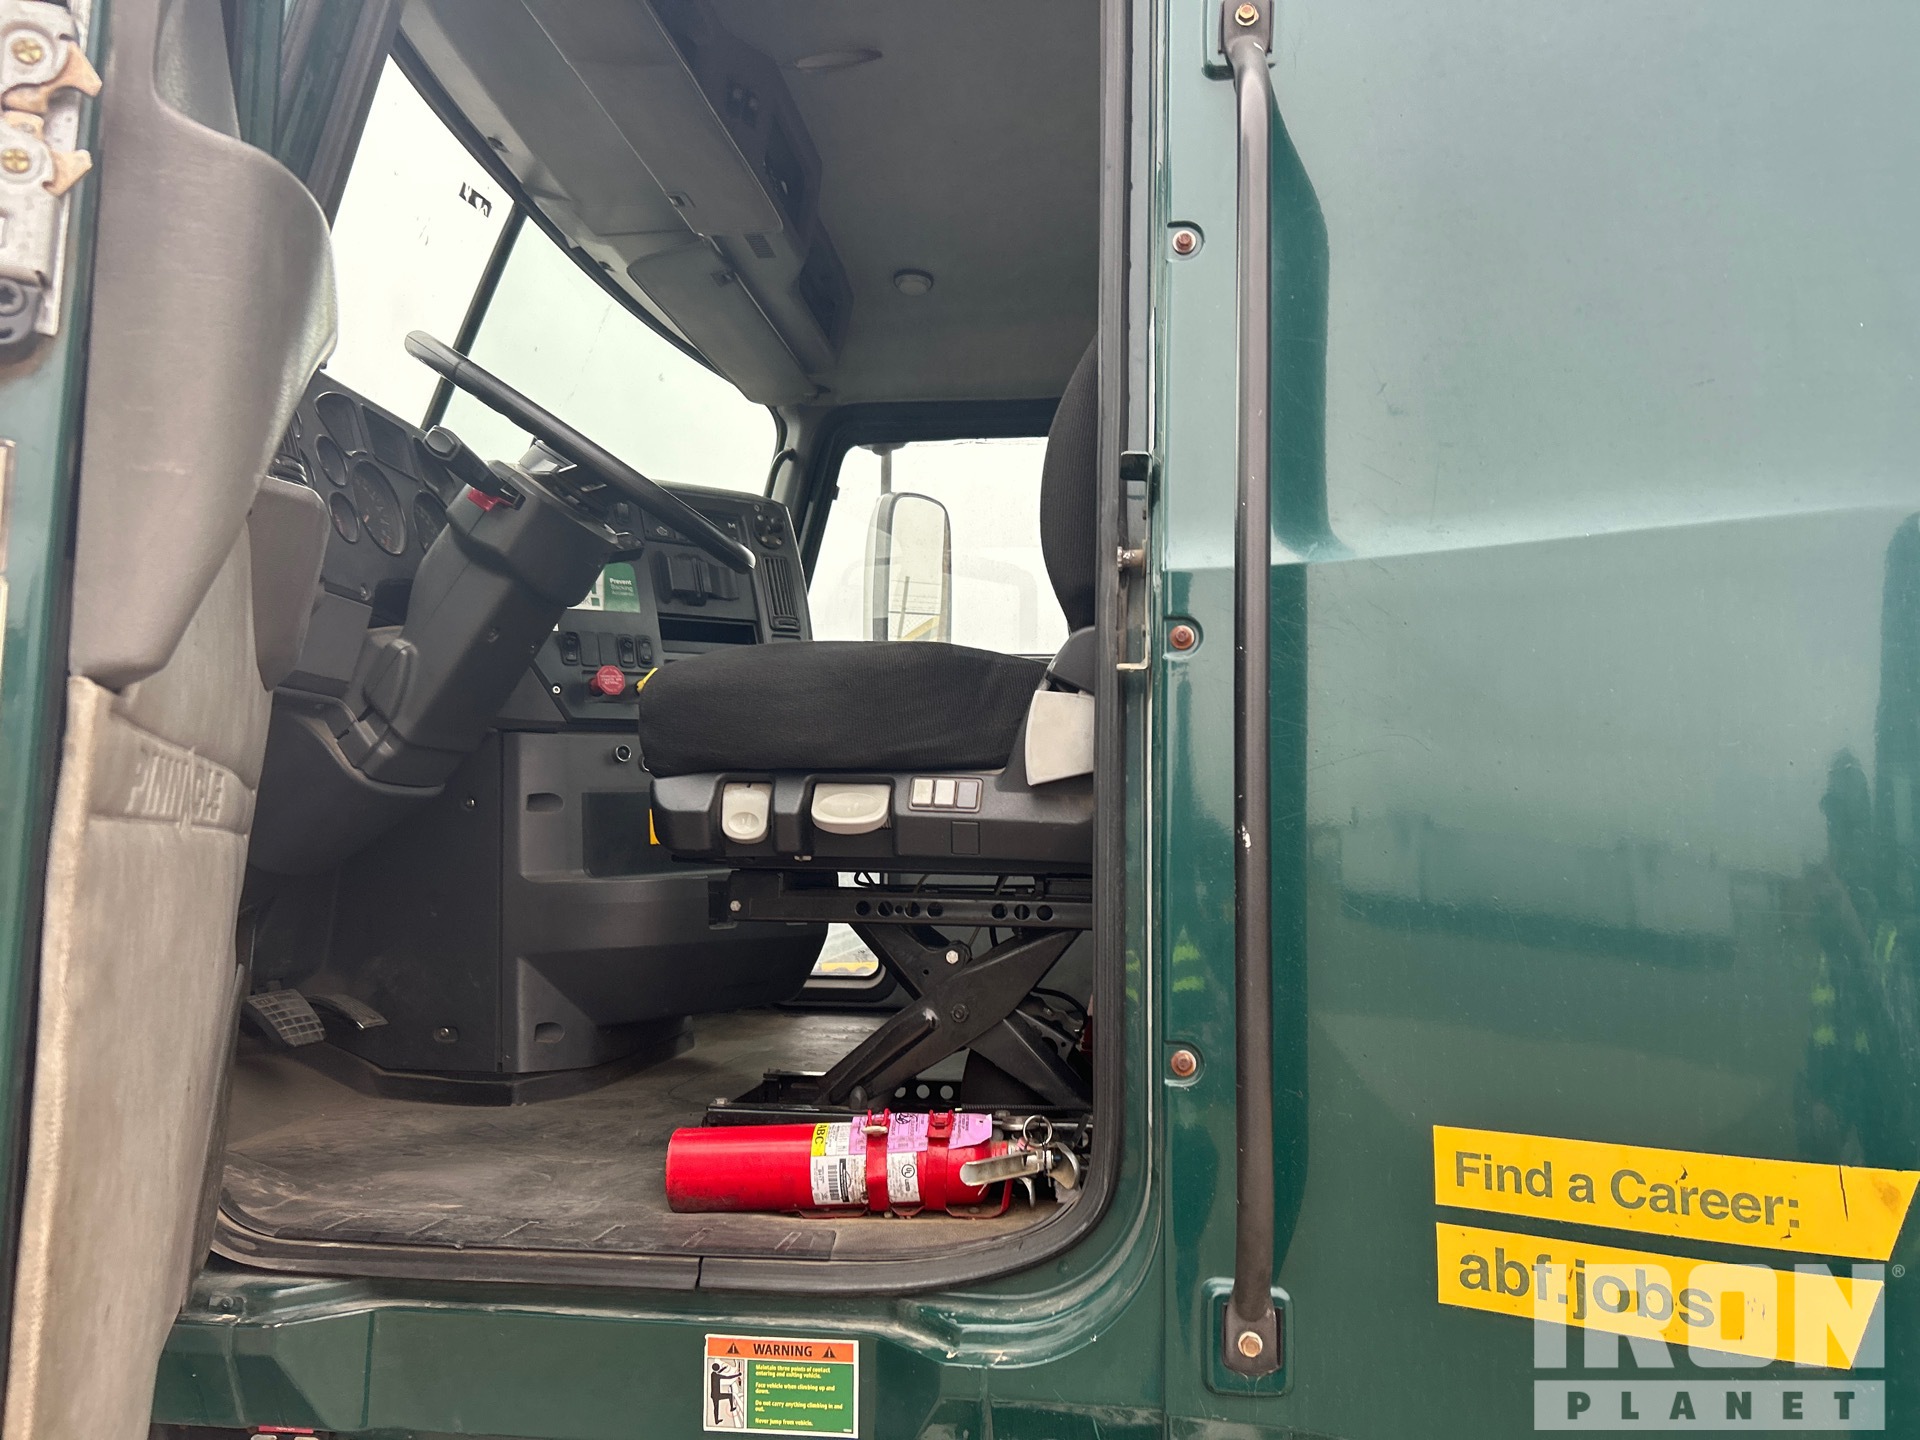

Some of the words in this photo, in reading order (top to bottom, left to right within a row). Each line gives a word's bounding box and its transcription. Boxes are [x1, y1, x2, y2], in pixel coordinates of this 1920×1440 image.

[610, 577, 632, 585] Prevent
[814, 1124, 827, 1144] ABC
[1455, 1151, 1553, 1198] Find
[1568, 1173, 1596, 1204] a
[1610, 1169, 1800, 1229] Career:
[1459, 1247, 1715, 1329] abf.jobs
[754, 1344, 812, 1356] WARNING
